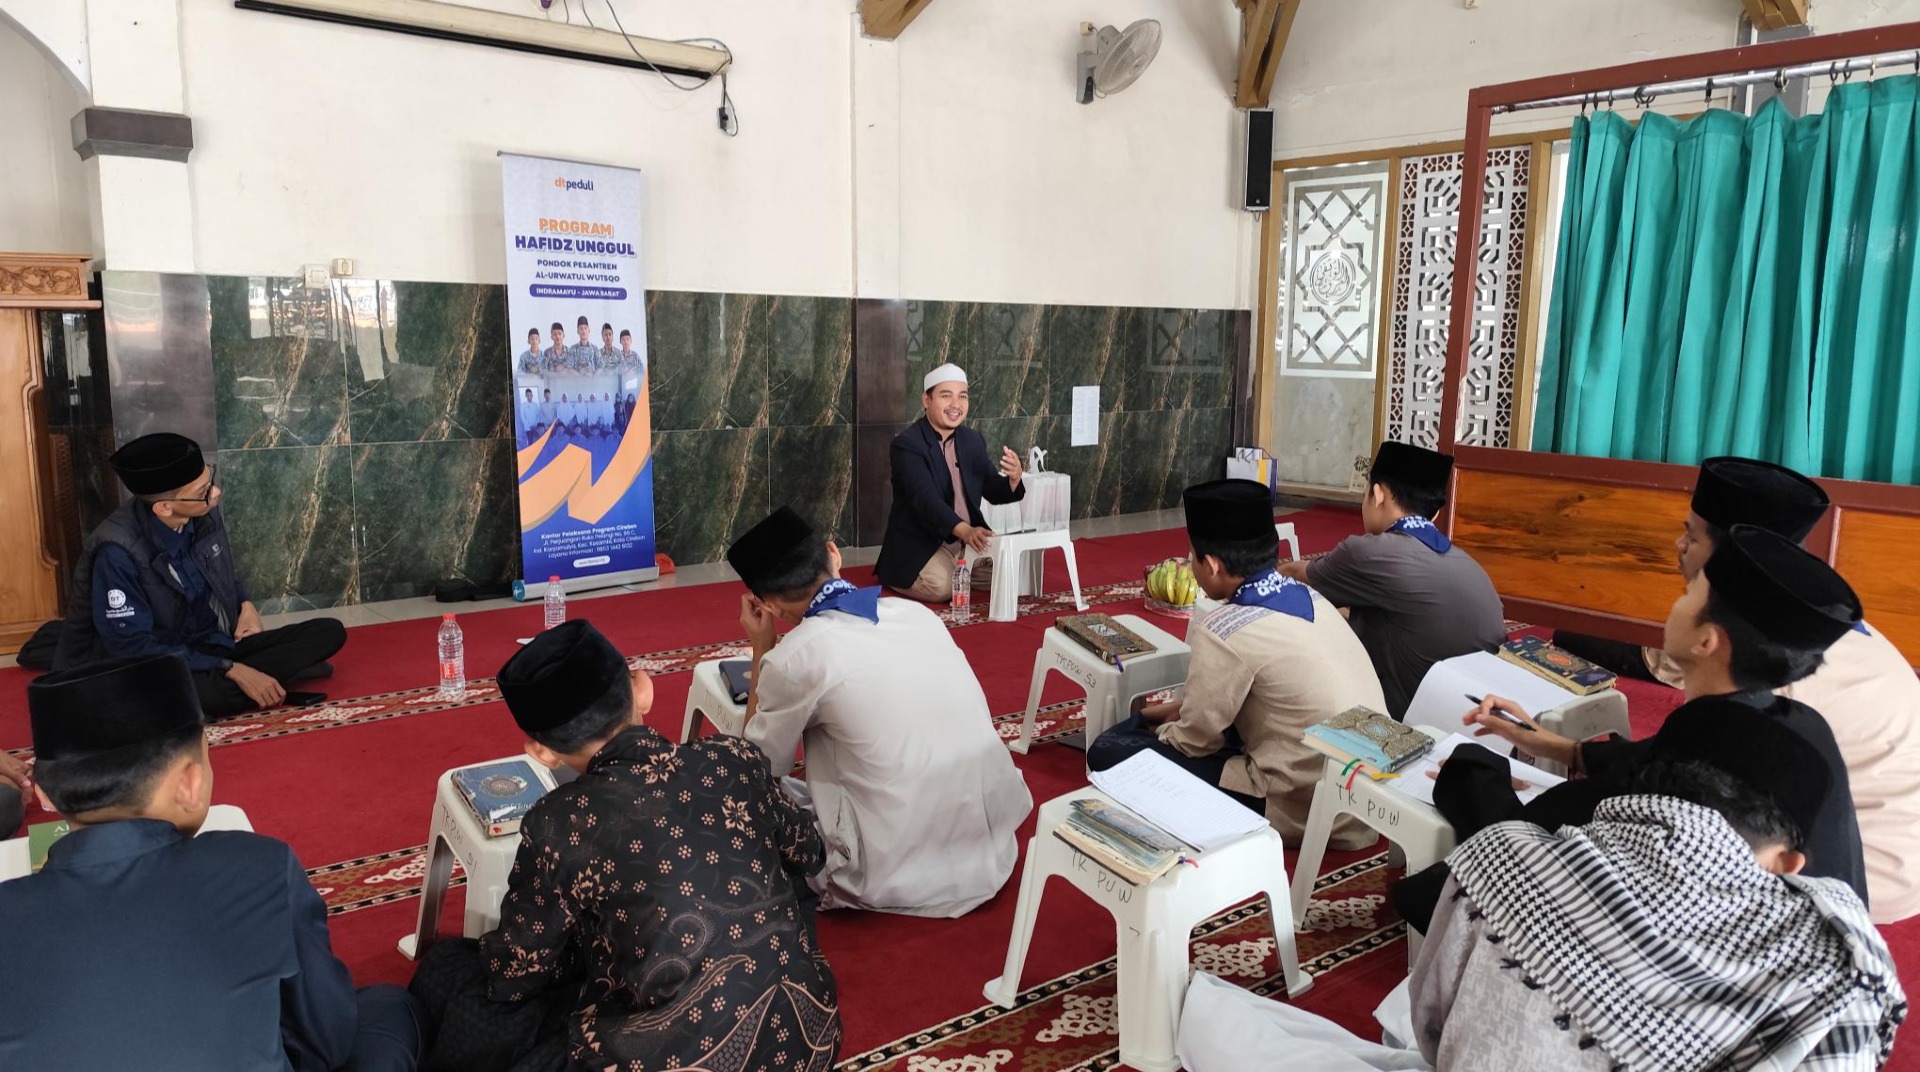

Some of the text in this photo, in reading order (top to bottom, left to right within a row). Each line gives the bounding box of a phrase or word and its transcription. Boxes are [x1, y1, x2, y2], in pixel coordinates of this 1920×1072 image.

[554, 177, 594, 191] dtpeduli
[538, 218, 613, 236] PROGRAM
[515, 235, 635, 256] HAFIDZ UNGGUL
[537, 259, 617, 270] PONDOK PESANTREN
[535, 272, 620, 283] AL-URWATUL WUTSQO
[536, 287, 576, 295] INDRAMAYU
[541, 532, 561, 540] Kantor
[592, 526, 616, 535] Program
[1336, 782, 1400, 827] TK PUW
[1097, 869, 1133, 903] PUW
